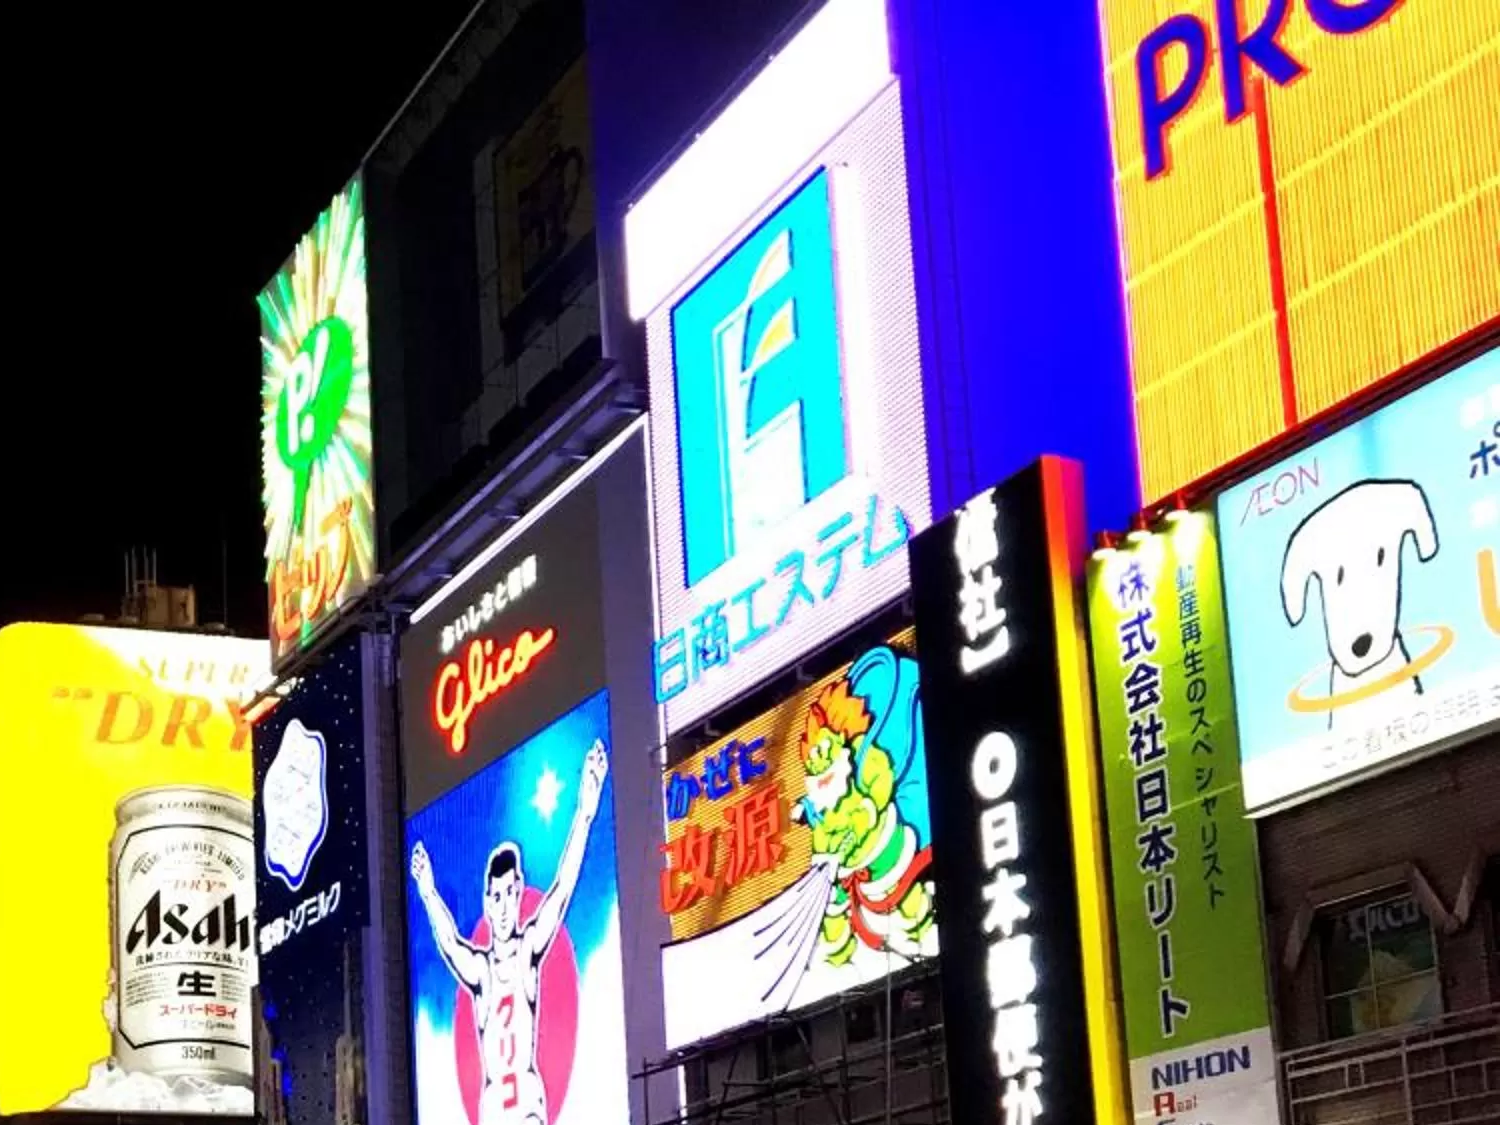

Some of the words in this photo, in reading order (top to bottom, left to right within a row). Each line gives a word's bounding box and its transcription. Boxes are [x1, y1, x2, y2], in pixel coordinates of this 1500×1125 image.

[273, 497, 354, 642] ピップ
[653, 490, 911, 706] 日商エステム
[435, 628, 555, 755] Glico
[665, 733, 770, 823] かぜに
[1117, 562, 1192, 1038] 株式会社日本リート
[658, 784, 788, 916] 改源
[125, 889, 252, 956] Asah
[159, 1003, 239, 1021] スーパードライ
[176, 970, 218, 998] 生
[180, 1046, 217, 1062] 350ml
[494, 992, 520, 1111] グリコ
[1151, 1045, 1251, 1091] NIHON
[1152, 1092, 1198, 1117] Real
